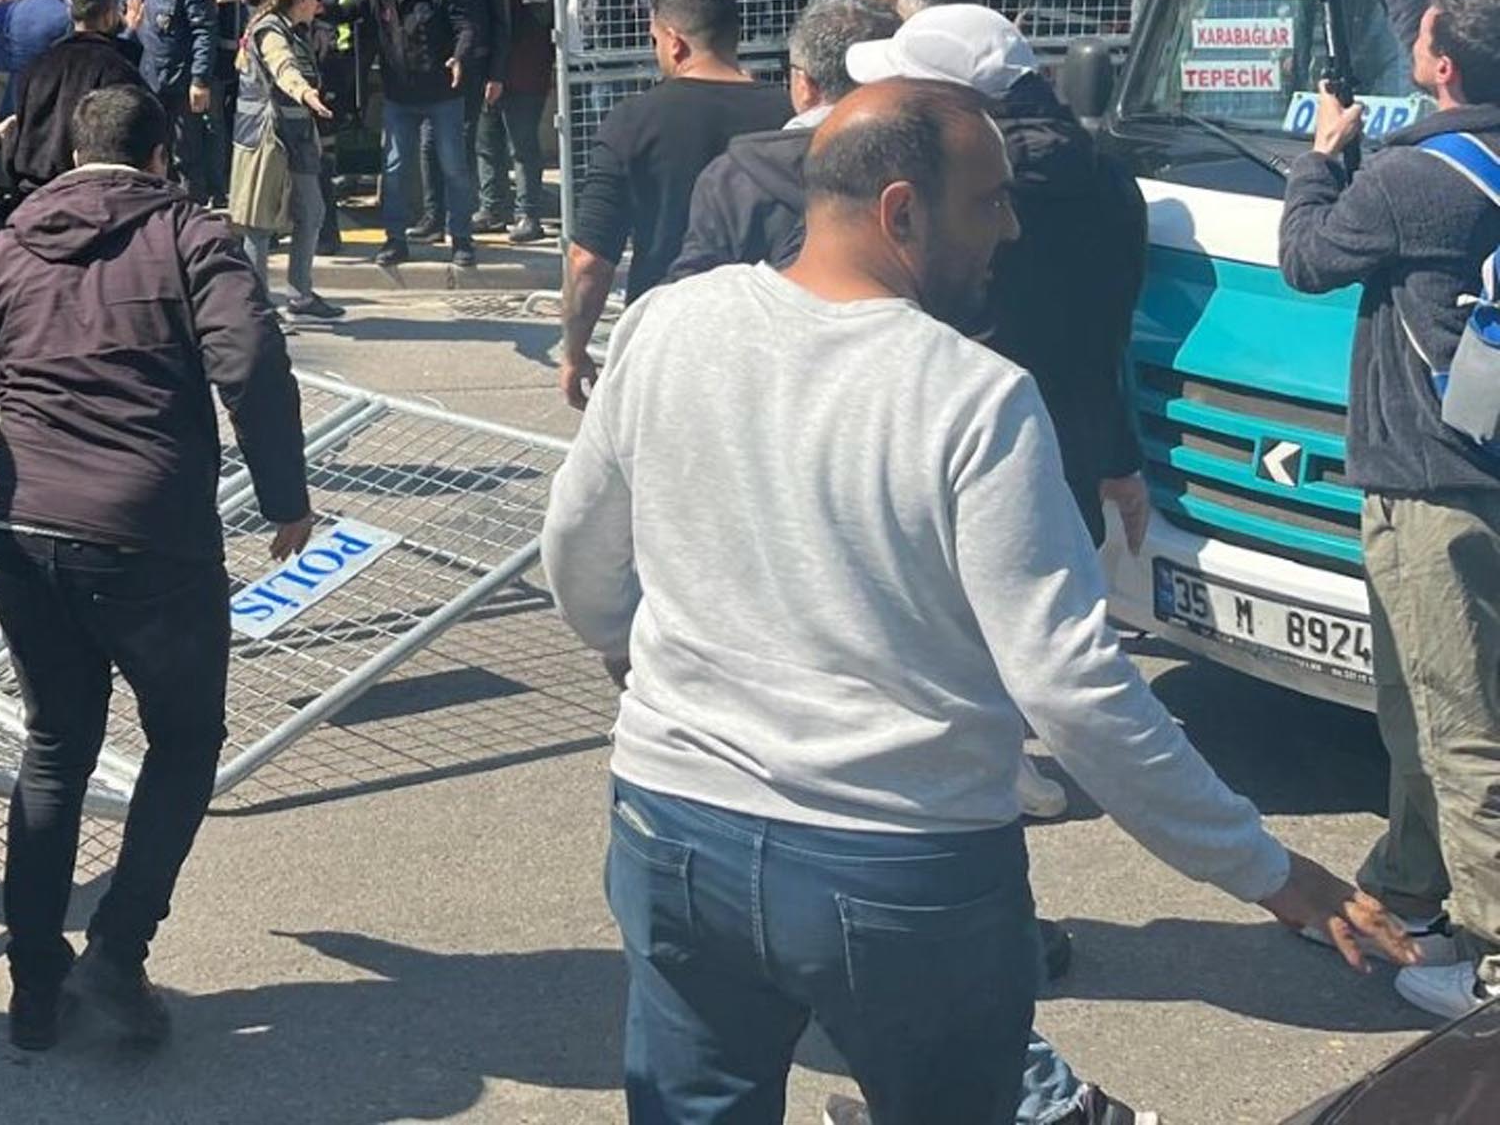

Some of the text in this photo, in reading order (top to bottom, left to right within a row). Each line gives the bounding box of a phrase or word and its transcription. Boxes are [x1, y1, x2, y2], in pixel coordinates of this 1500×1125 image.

[1197, 24, 1289, 46] KARABAĞLAR
[1184, 68, 1274, 88] TEPECİK
[231, 531, 373, 622] POLİS
[1174, 576, 1209, 618] 35
[1234, 595, 1254, 636] M
[1286, 611, 1371, 664] 8924
